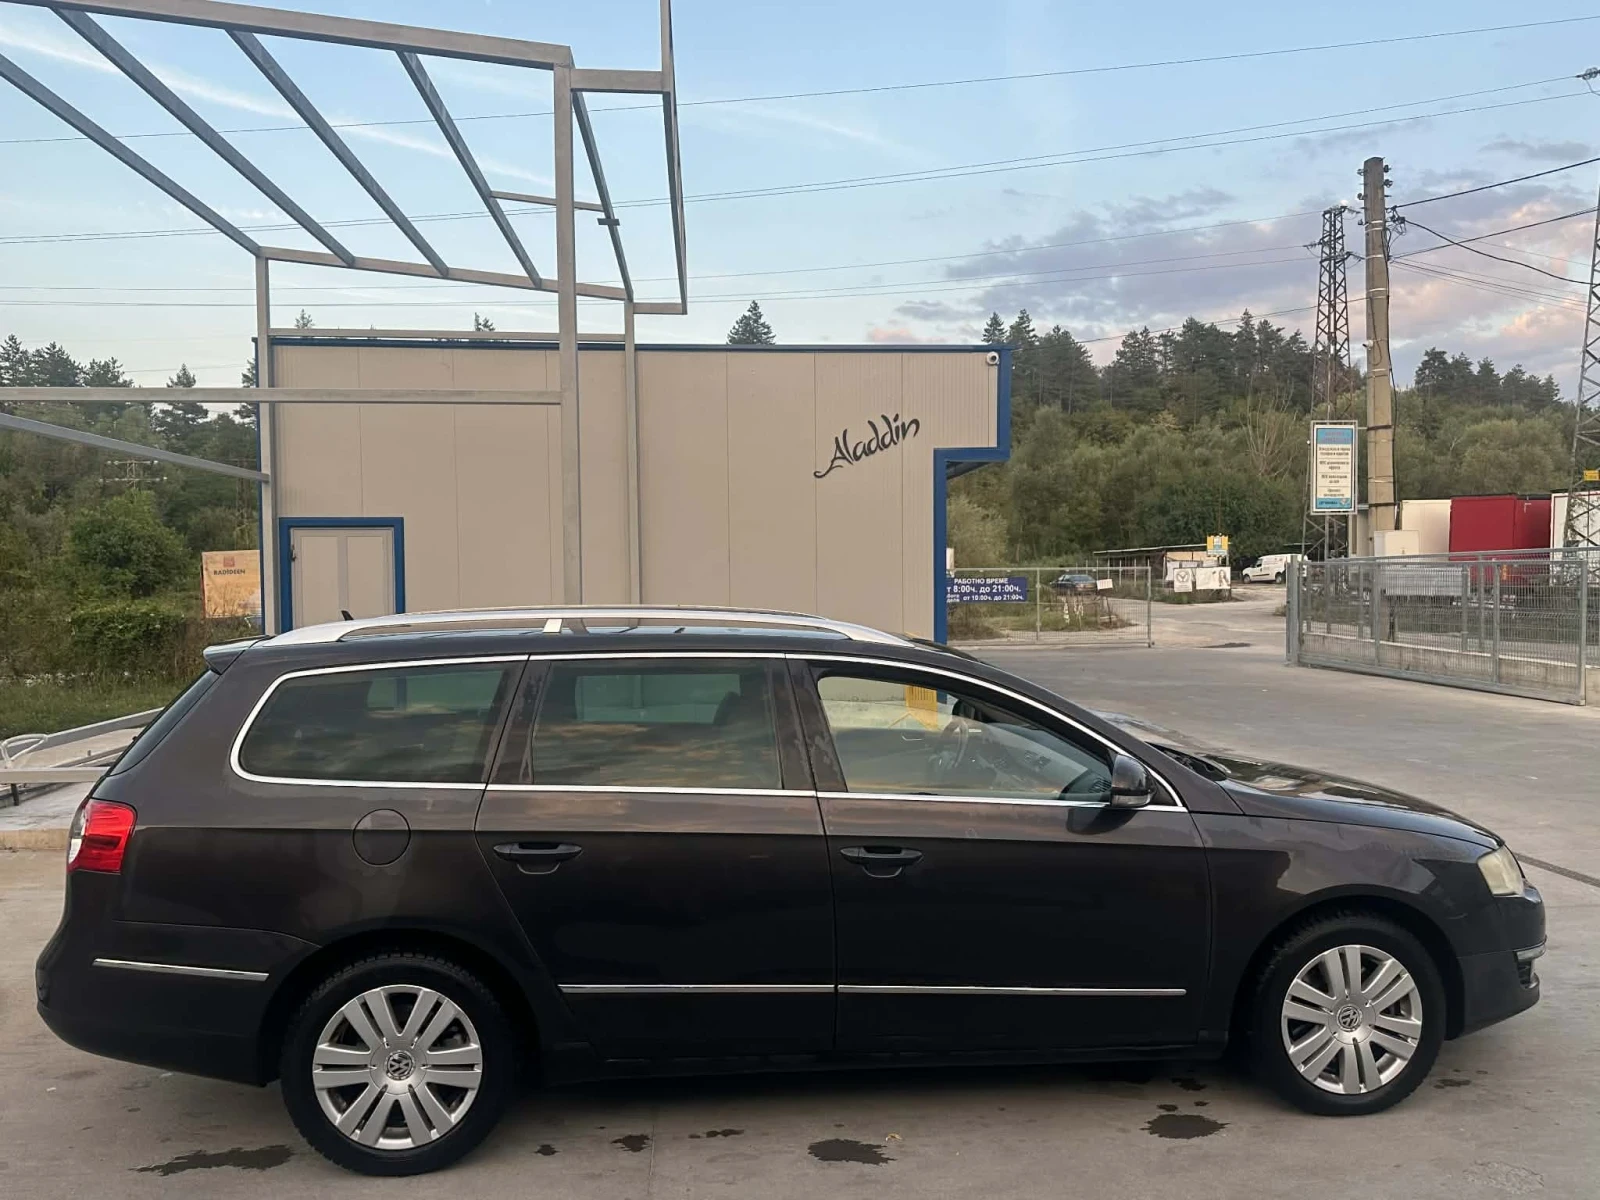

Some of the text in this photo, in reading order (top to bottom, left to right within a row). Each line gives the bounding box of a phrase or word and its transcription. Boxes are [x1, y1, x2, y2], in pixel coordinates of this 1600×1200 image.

[813, 413, 920, 478] Aladdin
[953, 585, 978, 593] 8:00ч.
[979, 586, 991, 594] до
[992, 585, 1022, 593] 21:00ч.
